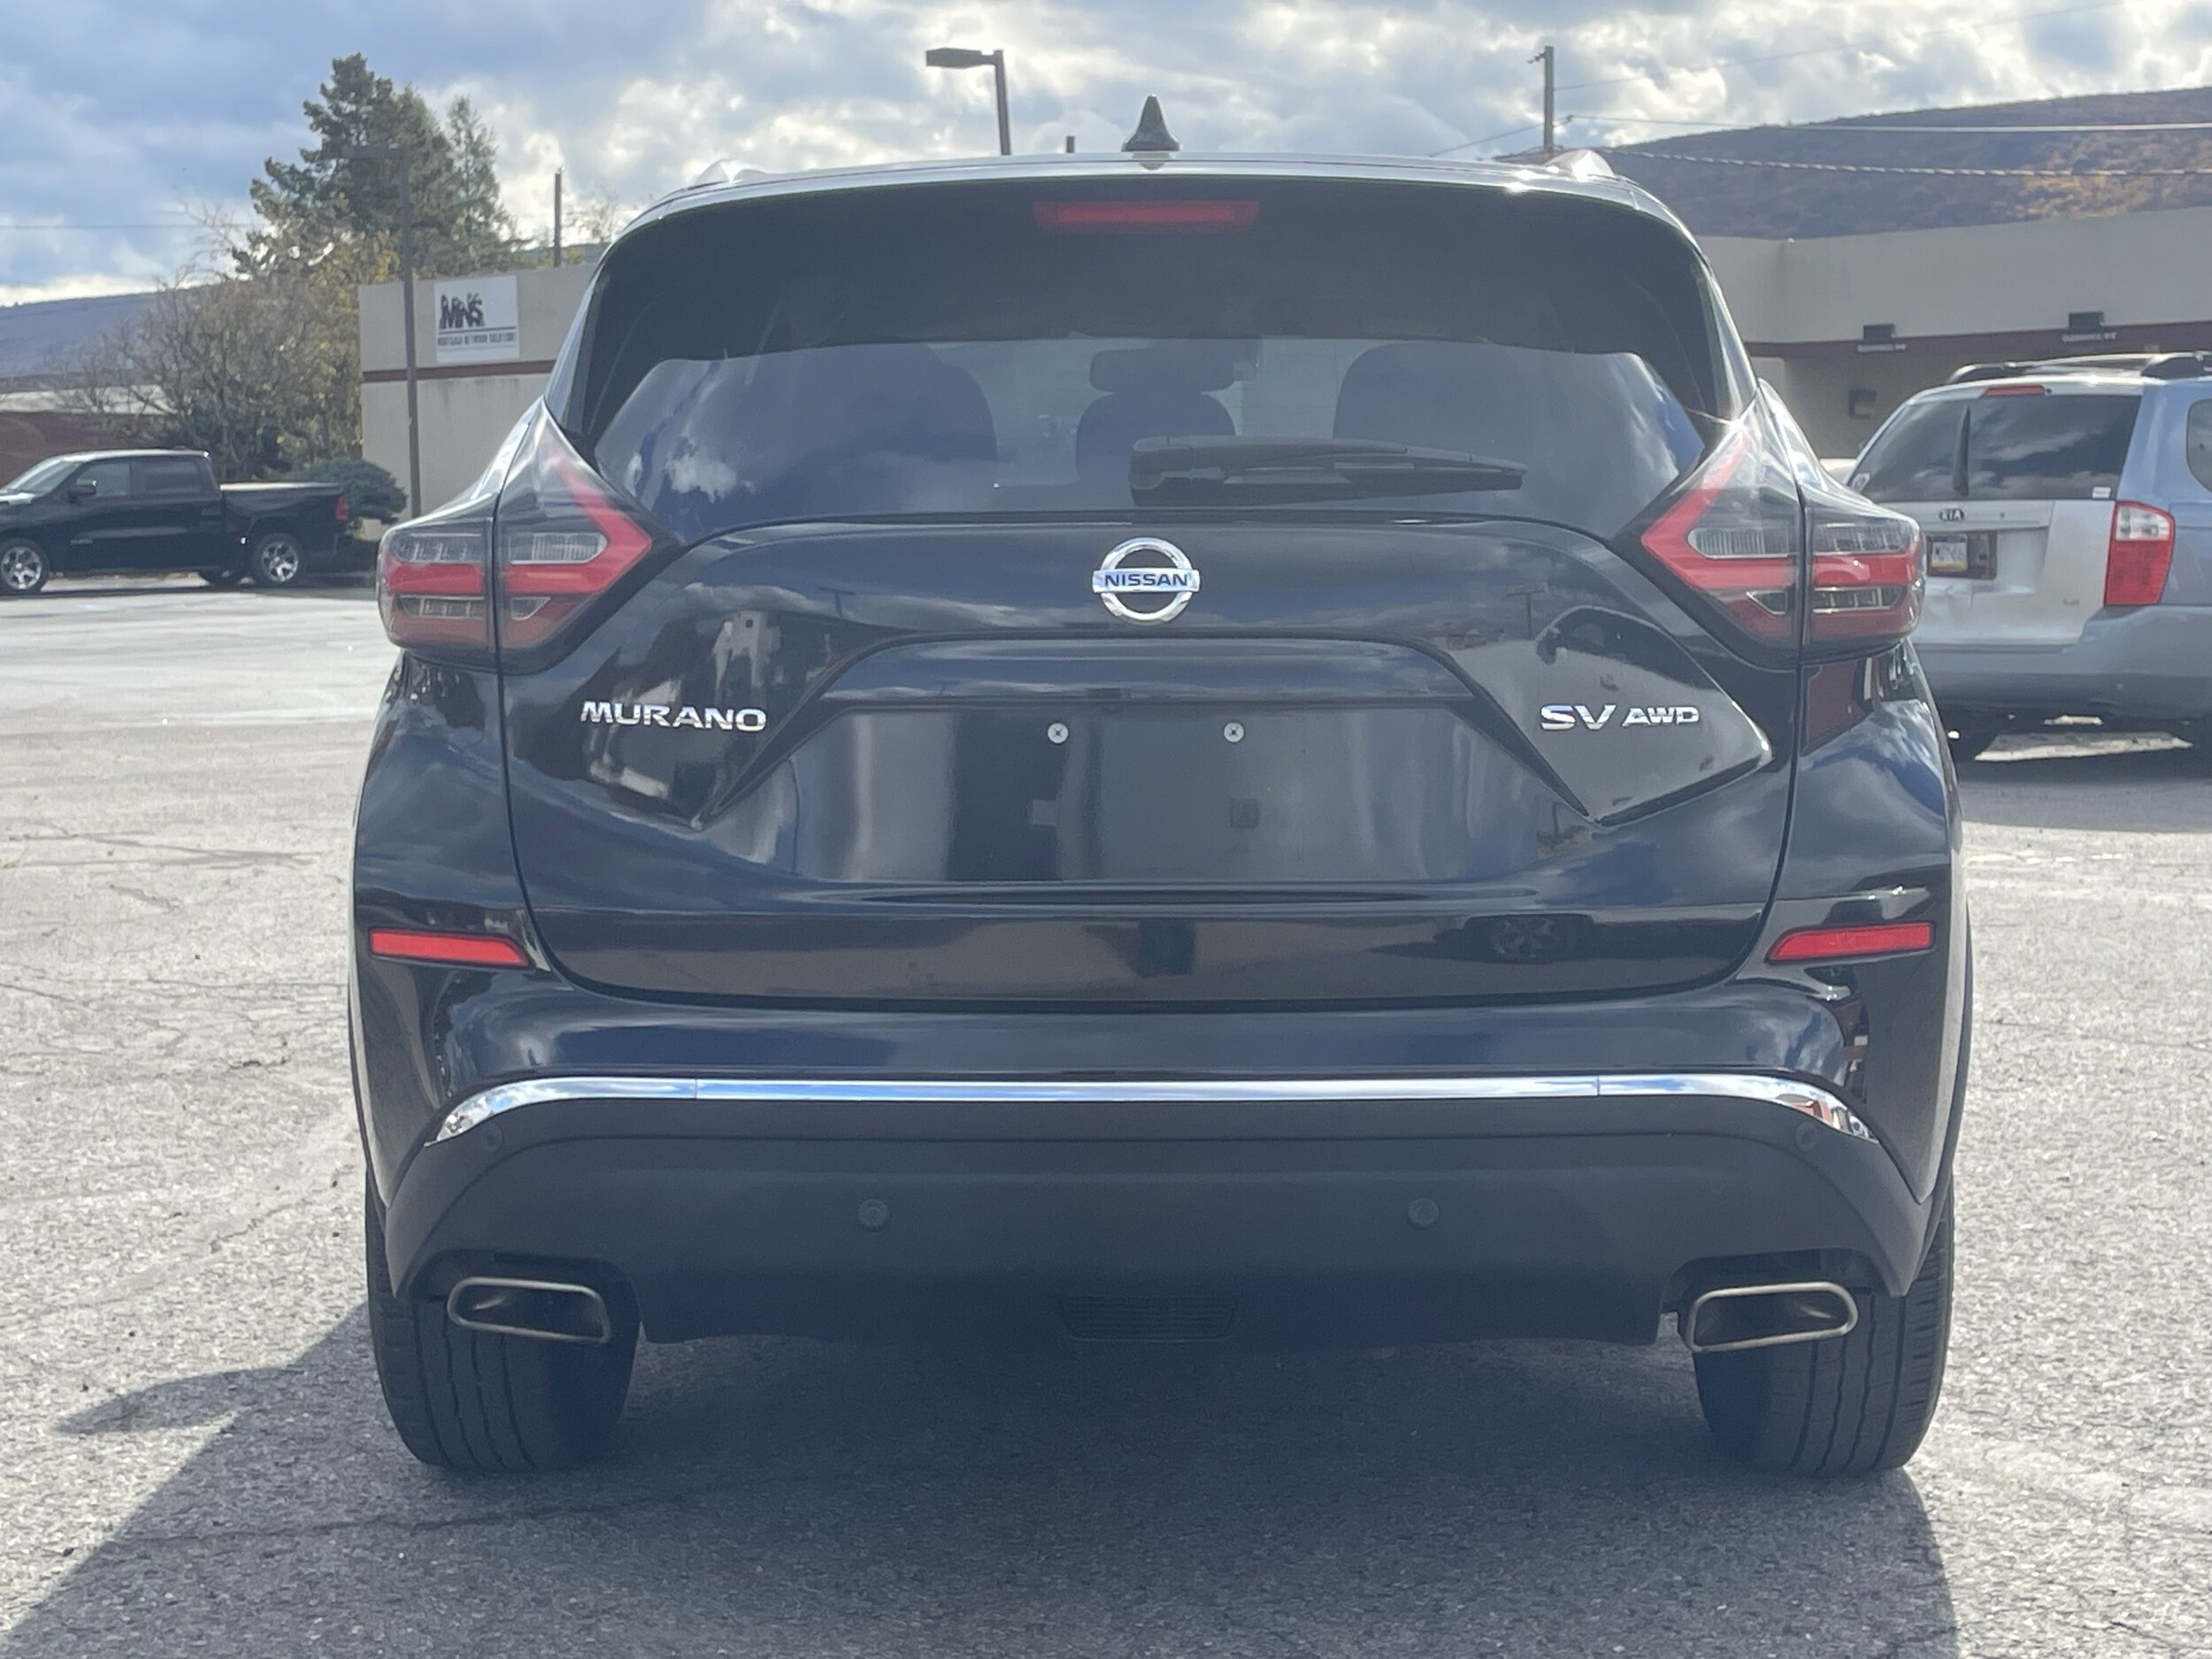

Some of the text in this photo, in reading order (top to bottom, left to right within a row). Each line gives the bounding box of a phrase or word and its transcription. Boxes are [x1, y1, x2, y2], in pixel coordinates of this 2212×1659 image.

[1939, 508, 1964, 521] KIA
[1104, 573, 1187, 587] NISSAN
[580, 701, 767, 732] MURANO
[1540, 704, 1700, 731] SV AWD
